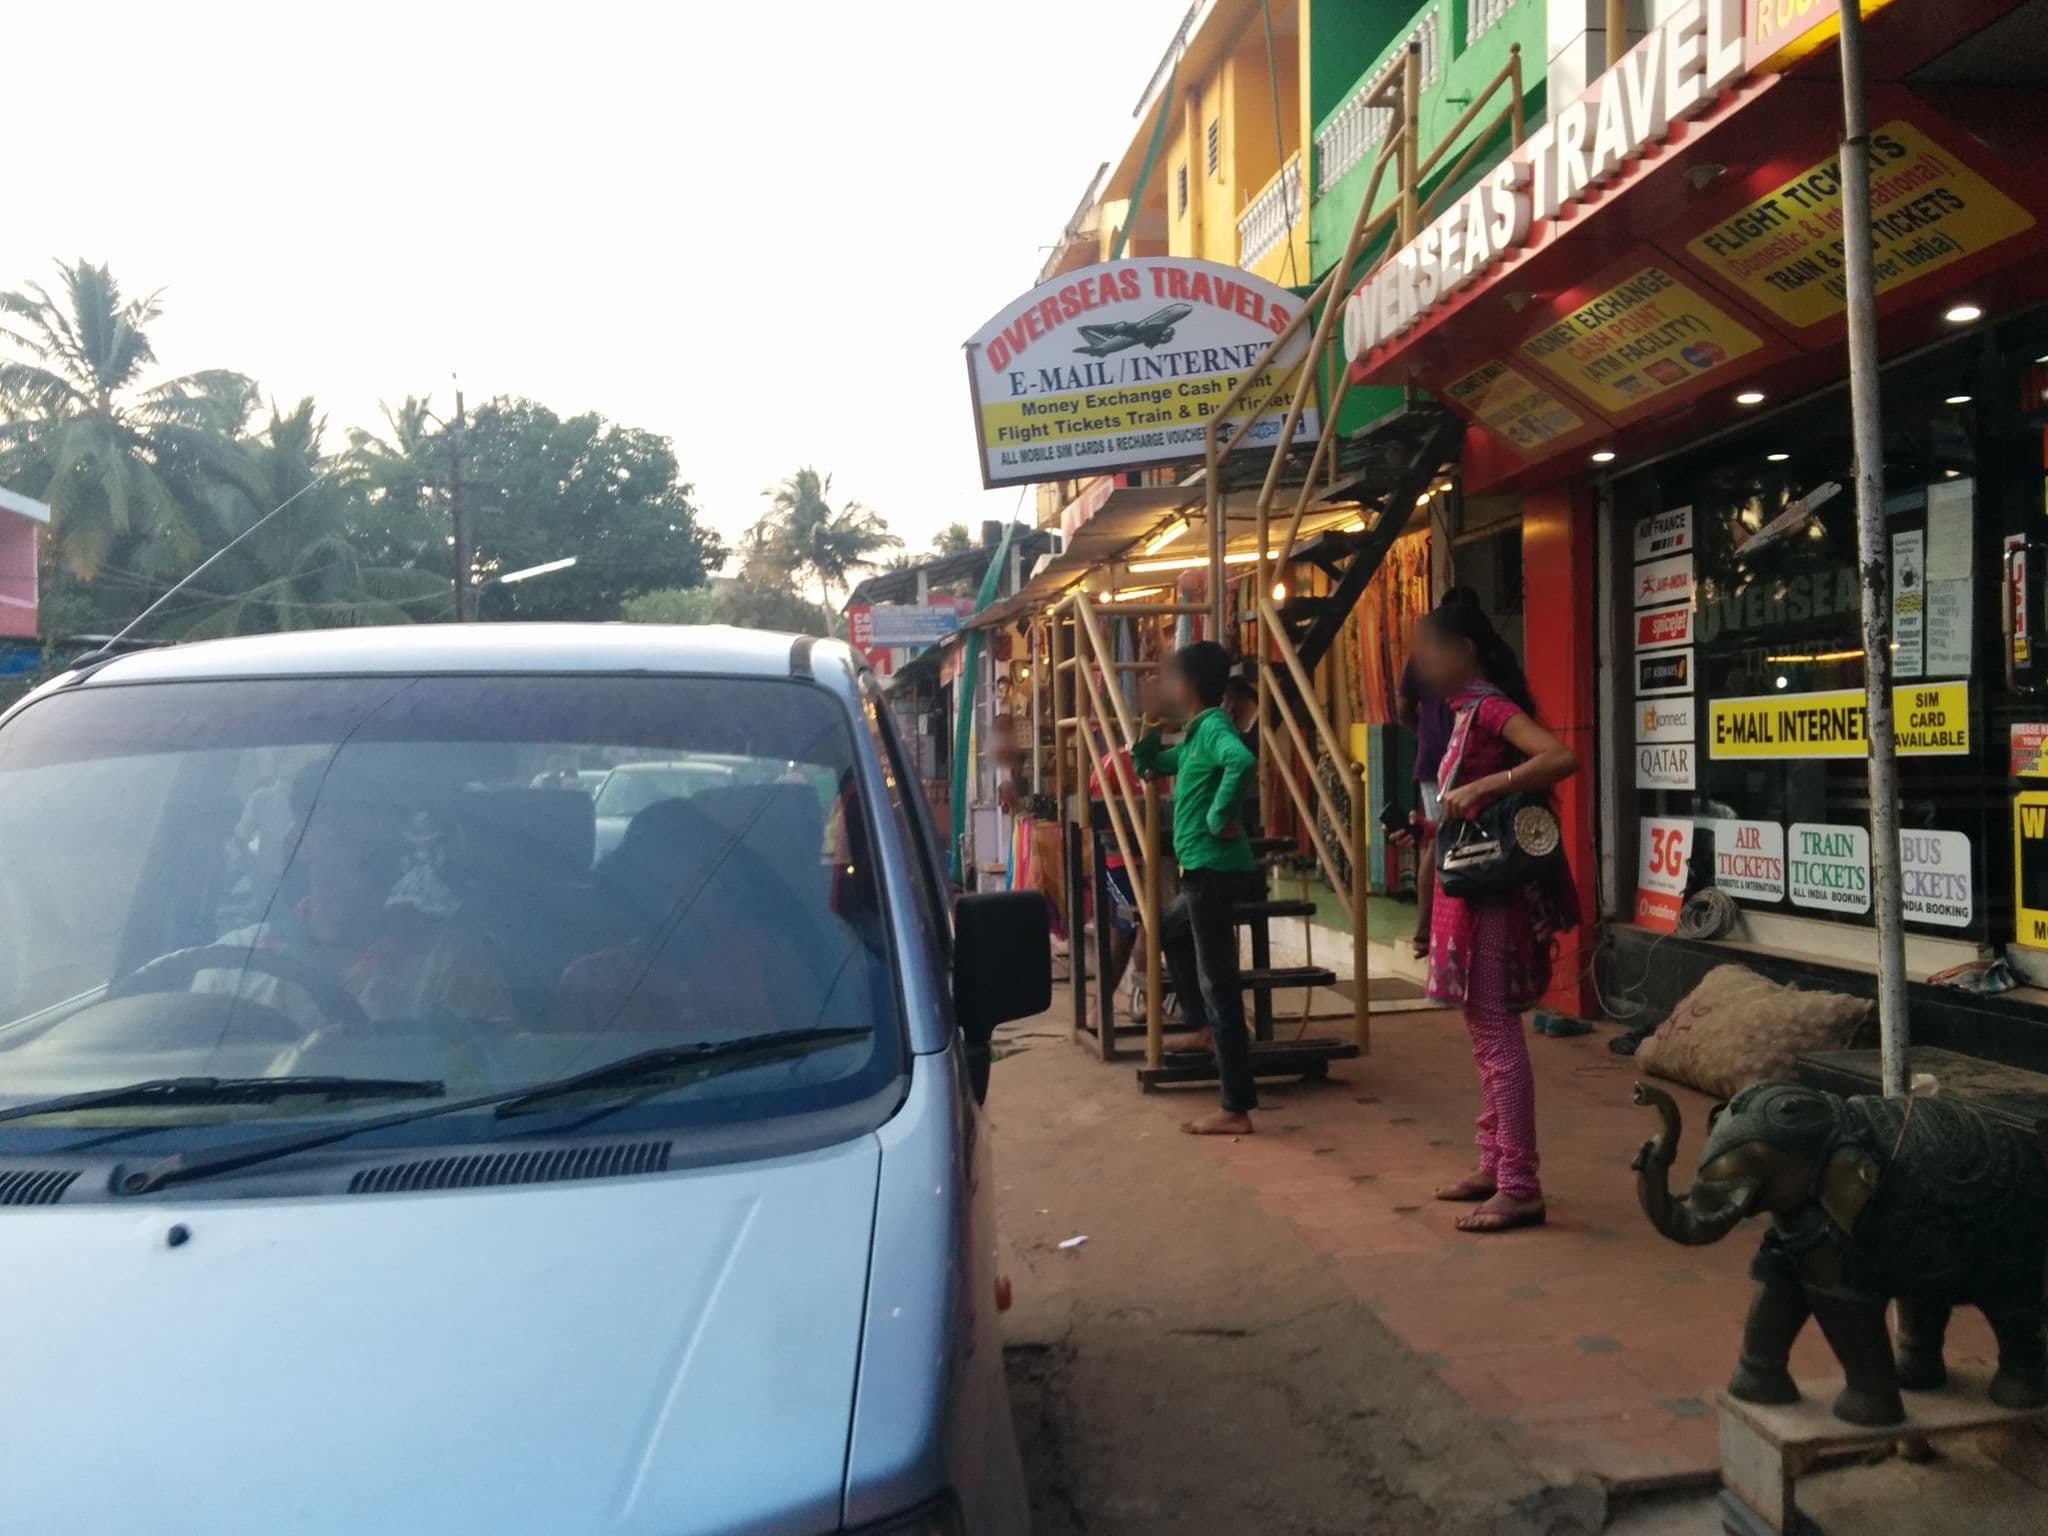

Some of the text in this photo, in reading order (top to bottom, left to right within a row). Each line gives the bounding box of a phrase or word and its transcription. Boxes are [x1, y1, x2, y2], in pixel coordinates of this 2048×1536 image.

[1704, 200, 1790, 256] FLIGHT
[1765, 257, 1826, 292] TRAIN
[1815, 250, 1842, 268] &
[1872, 188, 1965, 241] TICKETS
[1798, 220, 1825, 239] &
[1344, 162, 1522, 363] OVERSEAS
[987, 266, 1290, 373] OVERSEAS TRAVELS
[1524, 268, 1674, 356] MONEY EXCHANGE
[1566, 302, 1668, 362] CASH POINT
[1581, 351, 1624, 384] (ATM
[1620, 313, 1711, 363] FACILITY)
[1021, 399, 1079, 416] Money
[1086, 388, 1172, 408] Exchange
[1178, 379, 1221, 396] Cash
[998, 426, 1049, 441] Flight
[1055, 416, 1121, 434] Tickets
[1126, 408, 1172, 425] Train
[1179, 405, 1191, 419] &
[1001, 452, 1019, 466] ALL
[1020, 446, 1054, 463] MOBILE
[1056, 444, 1073, 458] SIM
[1074, 440, 1105, 456] CARDS
[1107, 439, 1115, 451] &
[1116, 433, 1164, 449] RECHARGE
[1654, 513, 1686, 533] FRANCE
[1916, 692, 1939, 708] SIM
[1717, 706, 1868, 743] E-MAIL INTERNET
[1910, 712, 1946, 728] CARD
[1895, 731, 1965, 747] AVAILABLE
[1641, 749, 1688, 777] QATAR
[1649, 827, 1683, 877] 3G
[1736, 827, 1761, 850] AIR
[1801, 831, 1854, 858] TRAIN
[1902, 837, 1941, 865] BUS
[1718, 853, 1781, 881] TICKETS
[1792, 860, 1866, 891] TICKETS
[1793, 887, 1867, 906] ALL INDIA BOOKING
[1902, 870, 1967, 901] CKETS
[1926, 902, 1968, 918] BOOKING
